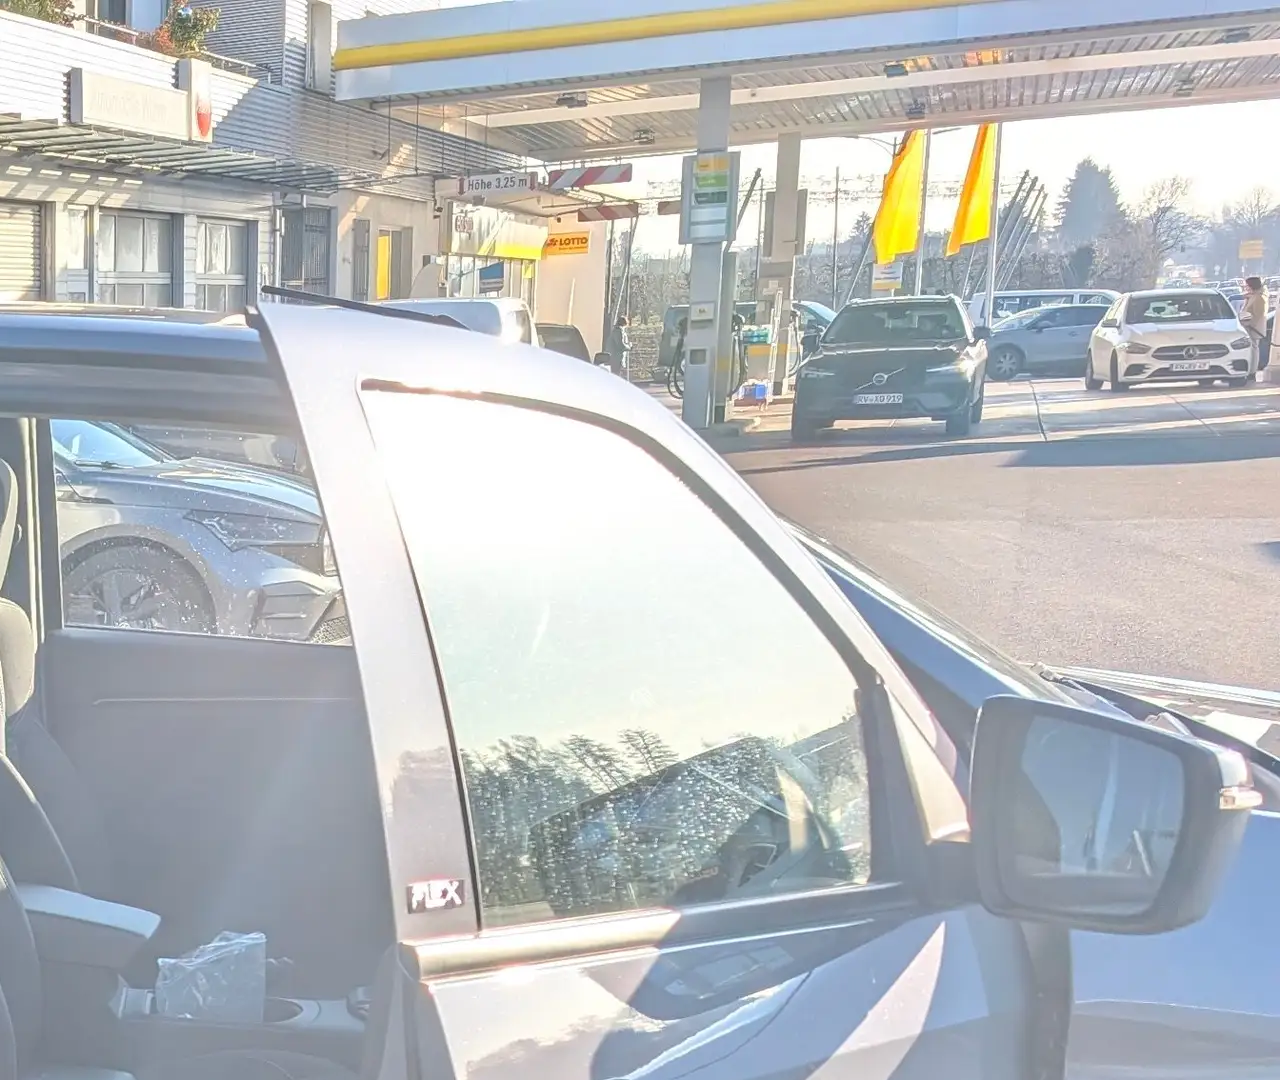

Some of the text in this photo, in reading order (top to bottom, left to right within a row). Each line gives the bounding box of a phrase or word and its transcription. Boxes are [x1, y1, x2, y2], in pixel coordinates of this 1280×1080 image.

[468, 179, 492, 191] Höhe
[518, 178, 528, 187] m
[559, 236, 588, 247] LOTTO
